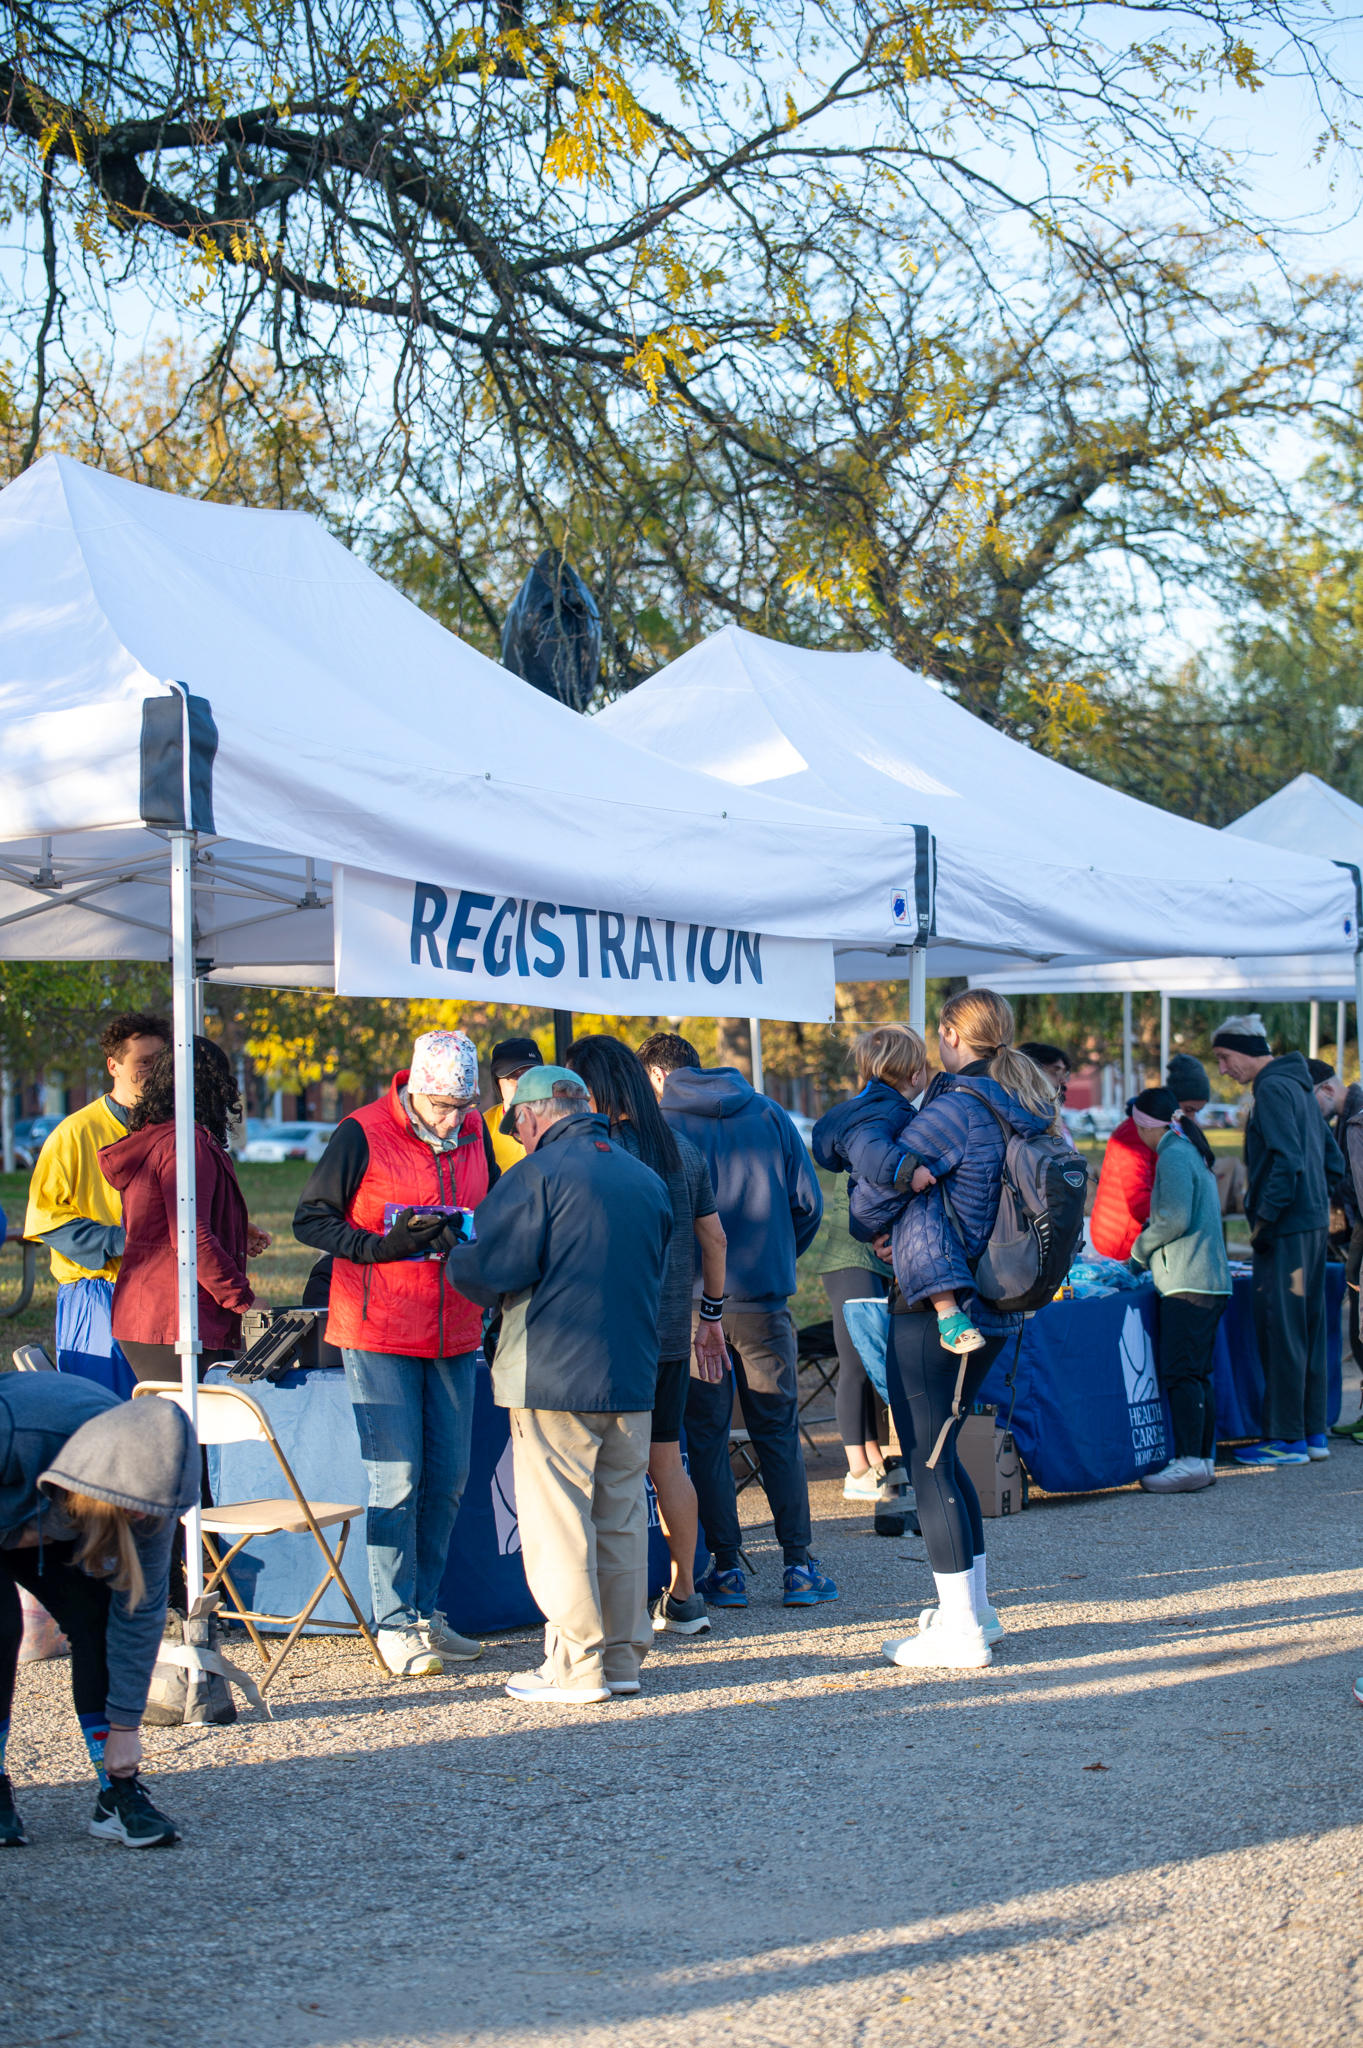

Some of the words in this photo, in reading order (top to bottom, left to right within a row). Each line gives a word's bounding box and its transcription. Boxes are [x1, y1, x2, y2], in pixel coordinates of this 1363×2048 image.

[410, 882, 763, 985] REGISTRATION
[1128, 1402, 1163, 1427] HEALTH
[1132, 1425, 1159, 1449] CARE
[1134, 1446, 1166, 1467] HOMELSS
